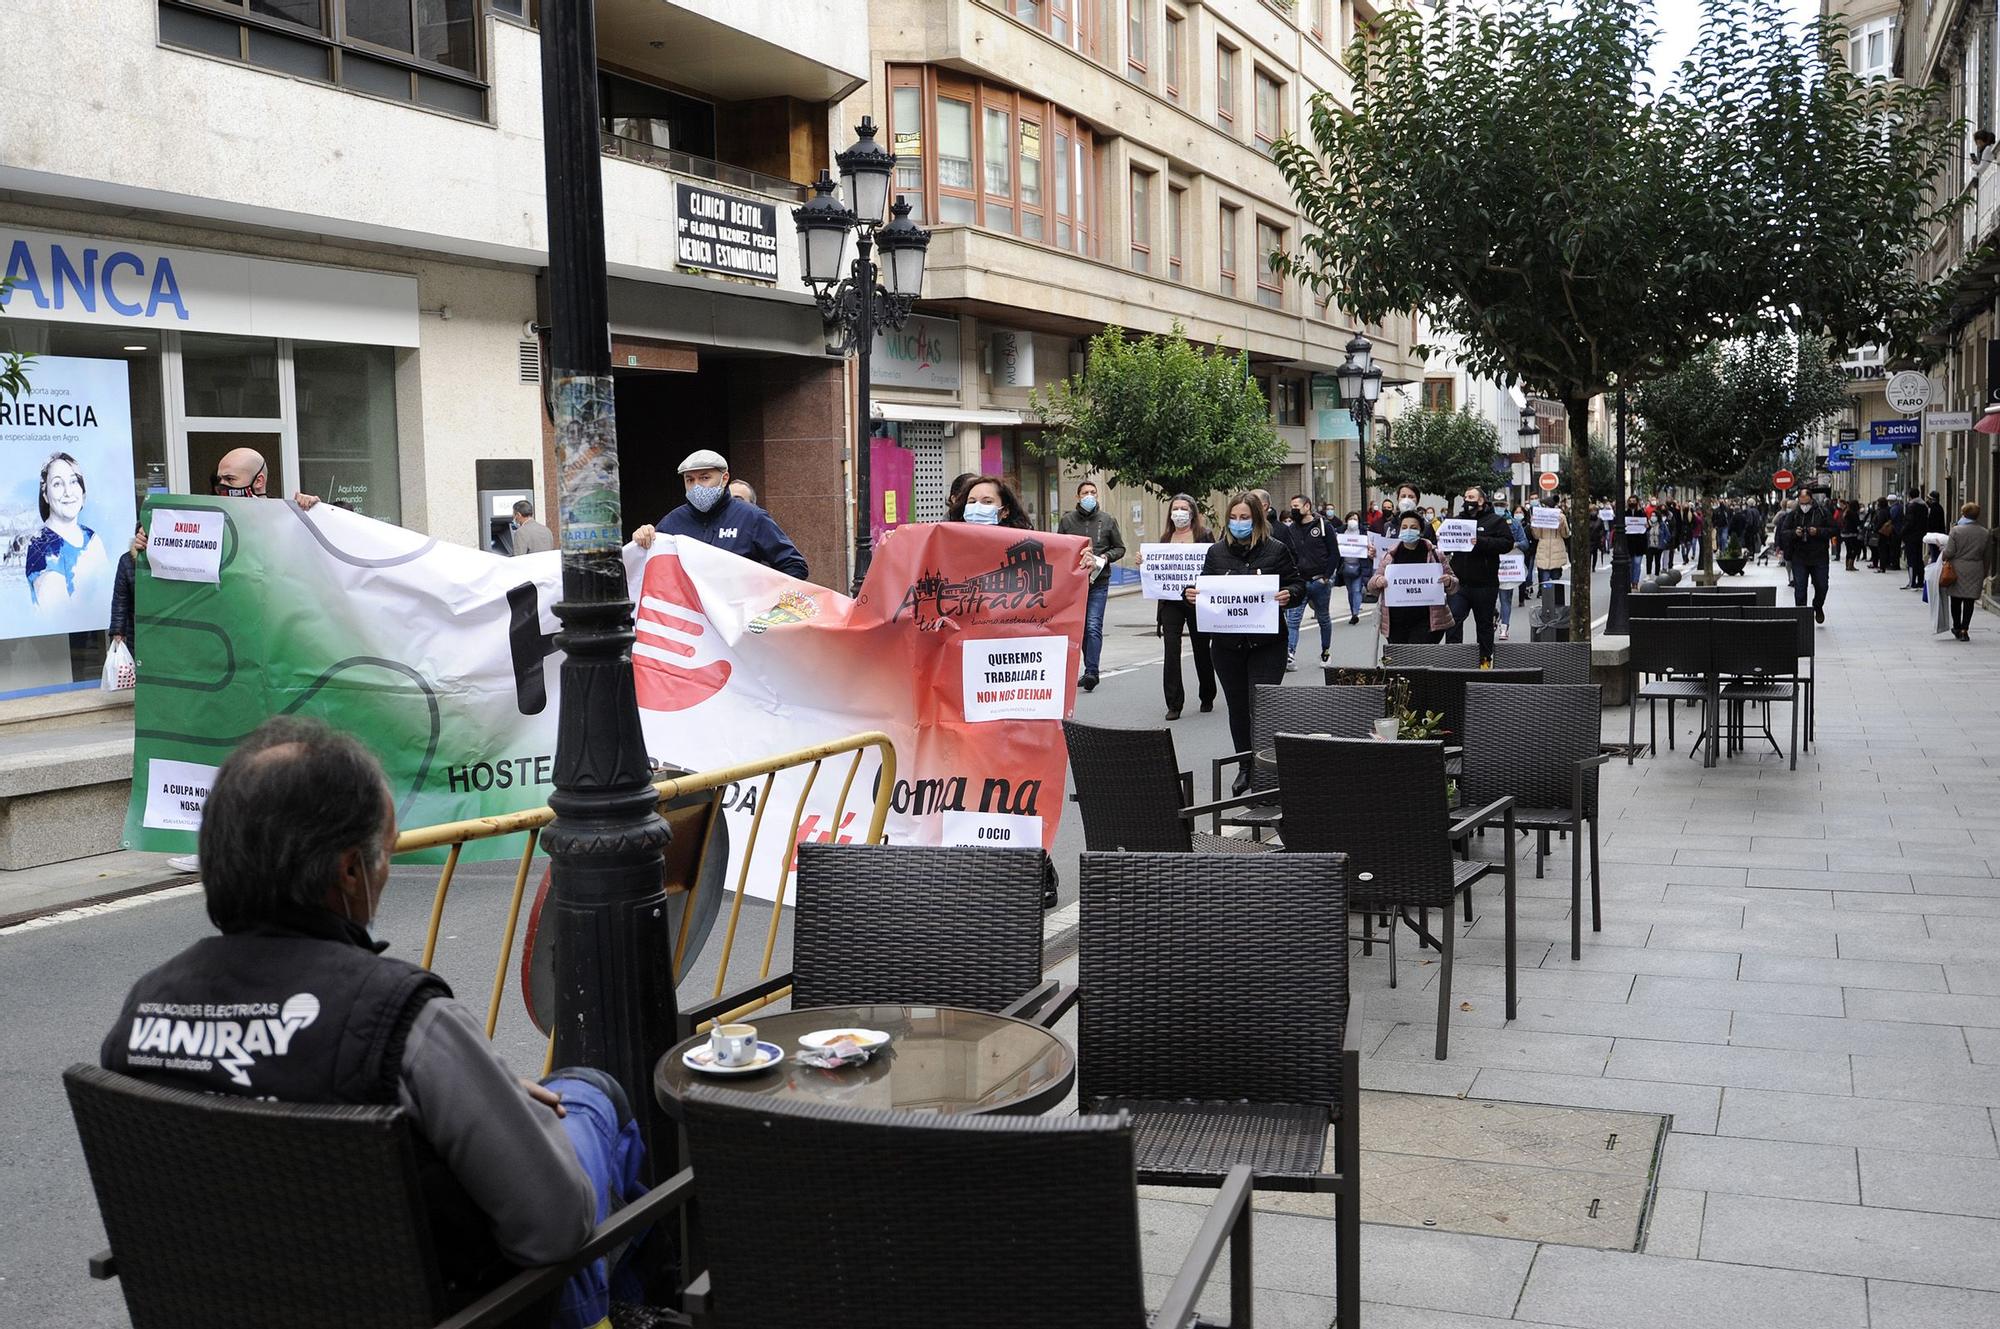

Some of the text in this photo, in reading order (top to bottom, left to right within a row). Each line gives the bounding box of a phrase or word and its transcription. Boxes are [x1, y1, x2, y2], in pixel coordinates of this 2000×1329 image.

[897, 132, 921, 143] VENDE
[690, 192, 763, 229] CLINICA DENTAL
[690, 220, 717, 239] GLORIA
[719, 226, 751, 246] VAZQUEZ
[752, 233, 777, 250] PEREZ
[679, 236, 777, 275] MEDICO ESTOMATOLOGO
[887, 324, 942, 364] MUCHAS
[1897, 398, 1924, 406] FARO
[1888, 424, 1918, 434] activa
[352, 484, 368, 493] todo
[174, 522, 201, 534] AXUDA!
[153, 537, 218, 551] ESTAMOS AFOGANDO
[1146, 553, 1184, 561] ACEPTAMOS
[1146, 563, 1160, 571] CON
[1161, 563, 1195, 571] SANDALIAS
[1154, 573, 1188, 581] ENSINADES
[1189, 573, 1194, 581] A
[1171, 583, 1180, 591] 20
[1210, 596, 1216, 604] A
[1217, 595, 1241, 604] CULPA
[1242, 595, 1258, 603] NON
[1227, 608, 1249, 617] NOSA
[988, 651, 1043, 666] QUEREMOS
[984, 669, 1046, 684] TRABALLAR E
[976, 688, 1053, 704] NON NOS DEIXAN
[163, 783, 169, 794] A
[170, 784, 194, 796] CULPA
[978, 777, 1042, 817] na
[180, 800, 201, 812] NOSA
[978, 827, 1011, 840] O OCIO
[137, 1002, 280, 1018] INSTALACIONES ELECTRICAS
[128, 1016, 302, 1062] VANIRAY
[165, 1058, 214, 1071] autorizado
